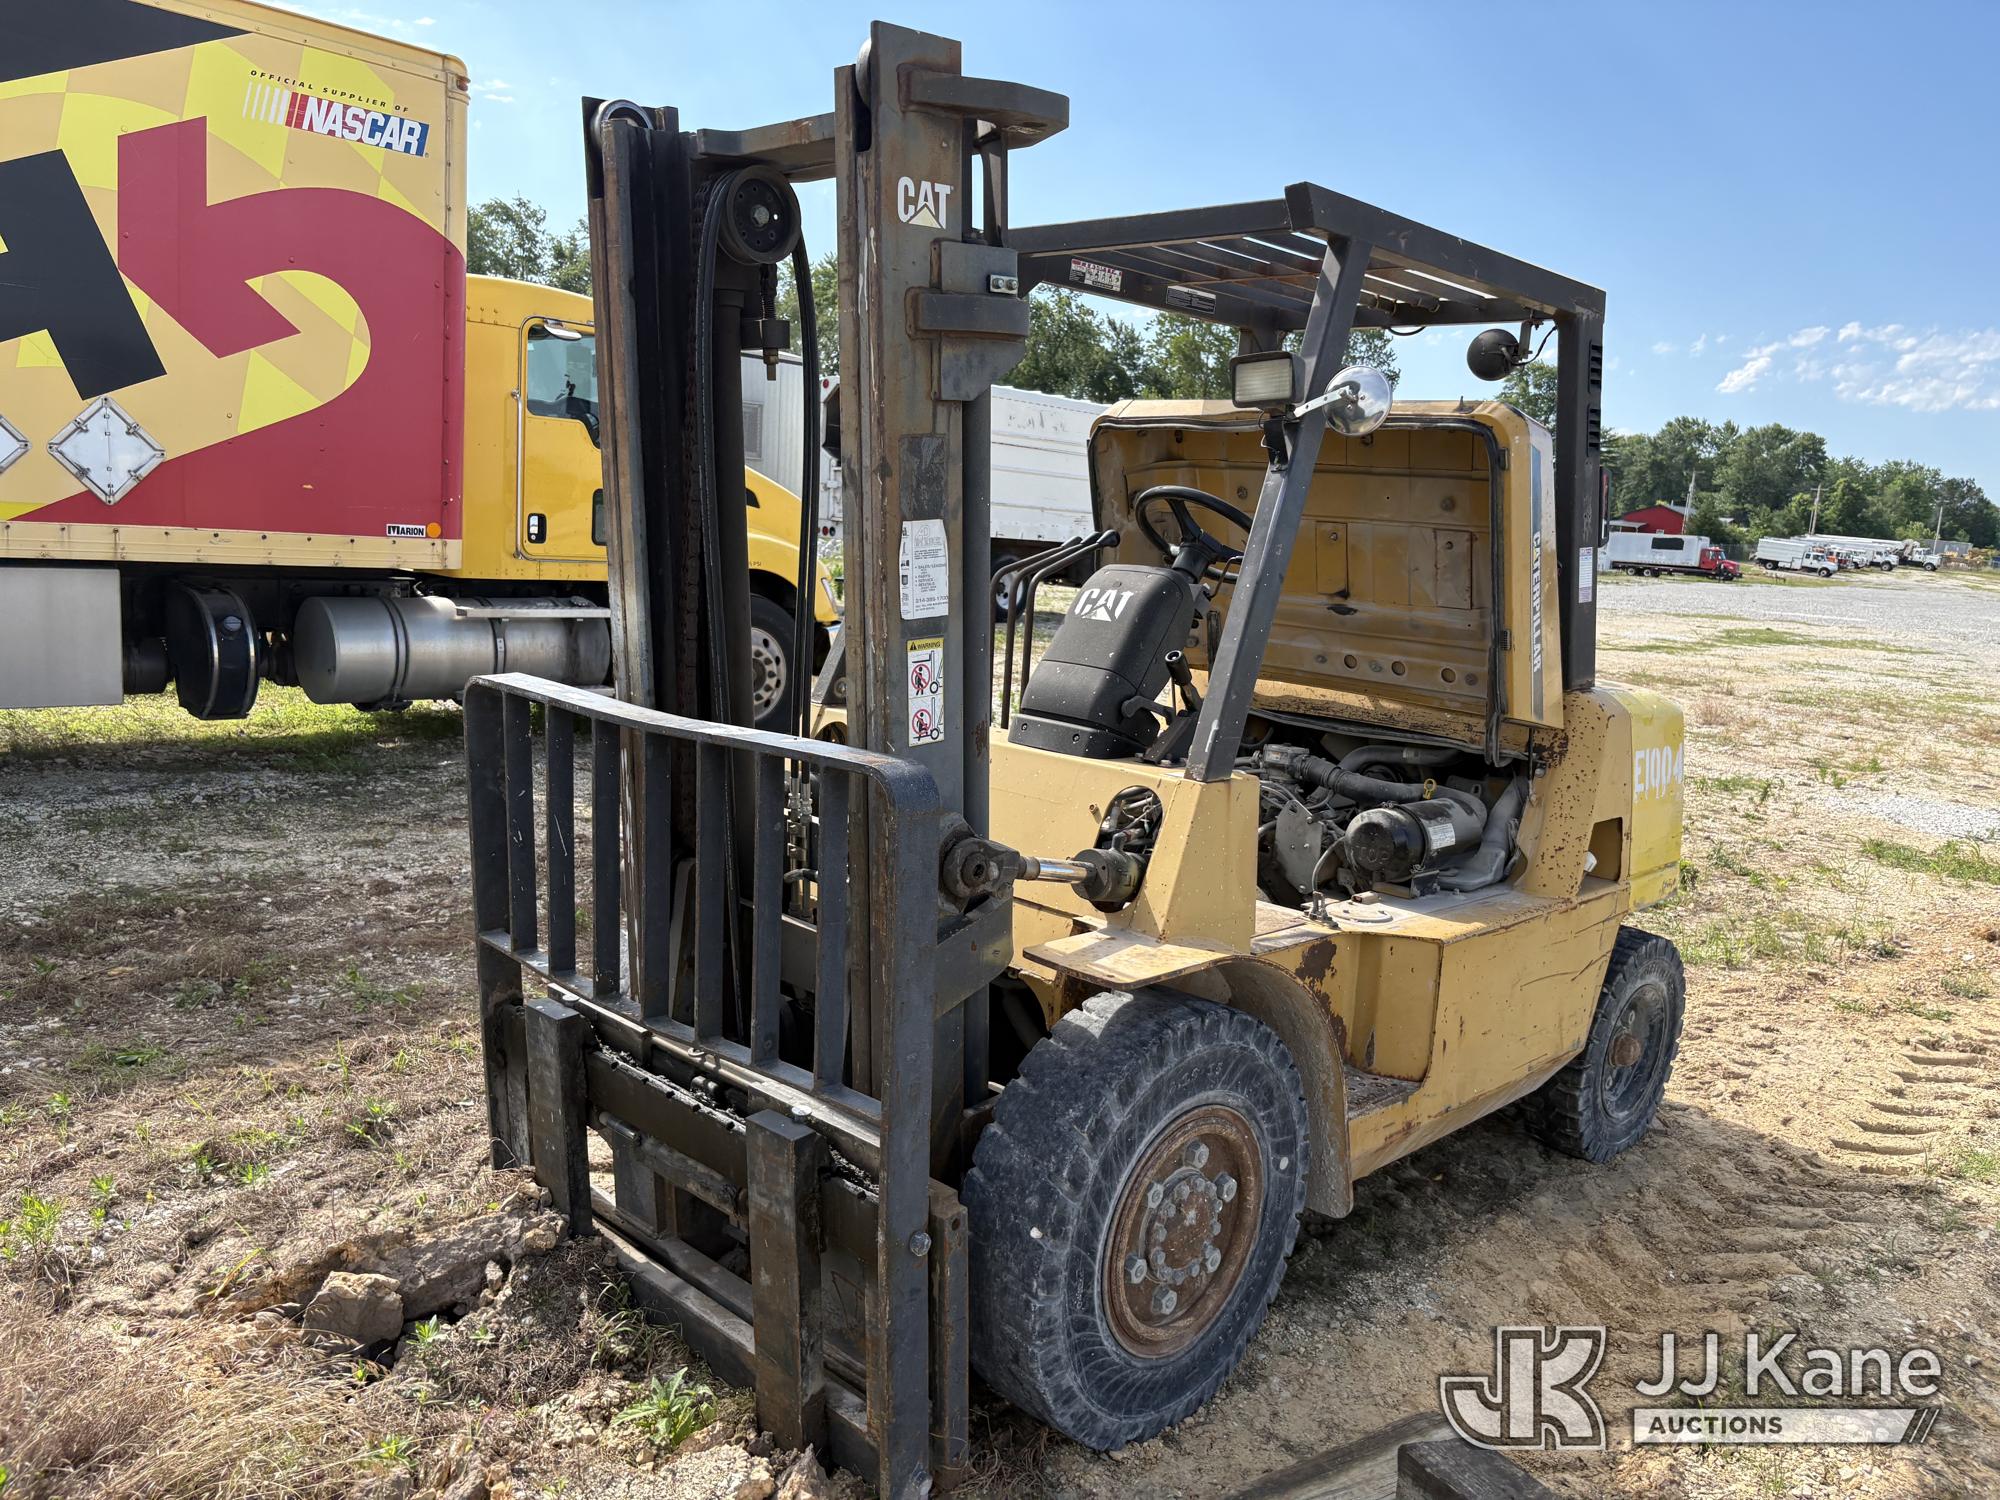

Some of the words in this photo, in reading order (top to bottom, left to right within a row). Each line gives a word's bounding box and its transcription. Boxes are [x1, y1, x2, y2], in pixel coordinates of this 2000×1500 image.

[250, 70, 314, 90] OFFICIAL
[323, 87, 387, 108] SUPPLIER
[394, 104, 410, 113] OF
[302, 96, 422, 155] NASCAR
[897, 176, 951, 230] CAT
[387, 525, 425, 536] MARION
[1074, 588, 1135, 620] CAT
[1532, 531, 1542, 673] CATERPILLAR
[917, 641, 941, 650] WARNING
